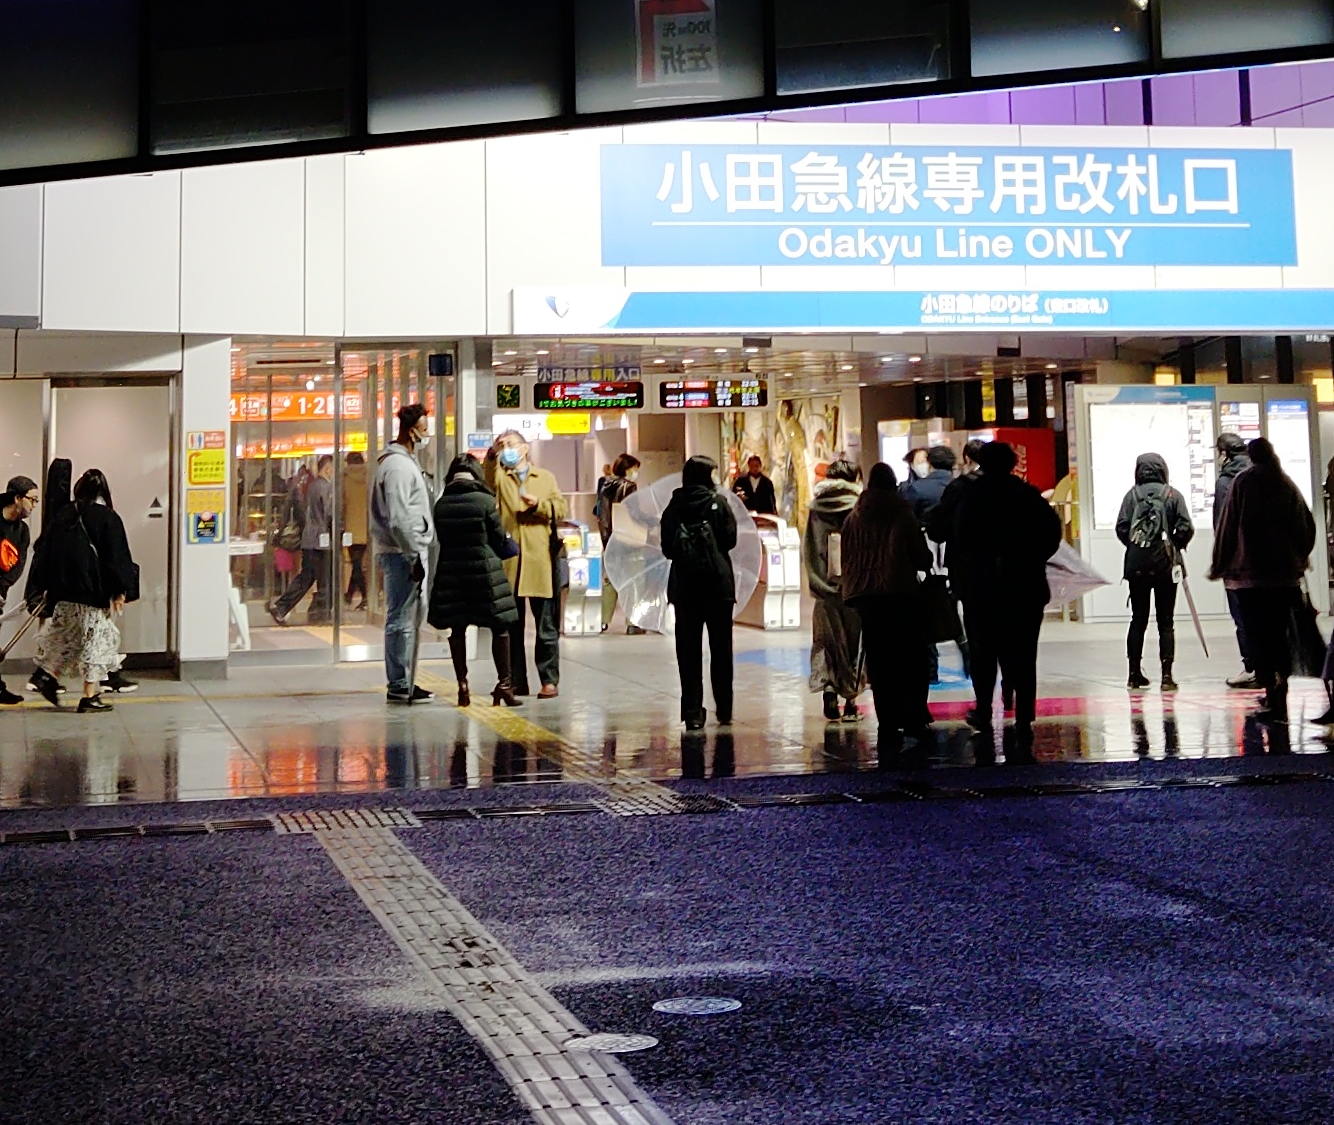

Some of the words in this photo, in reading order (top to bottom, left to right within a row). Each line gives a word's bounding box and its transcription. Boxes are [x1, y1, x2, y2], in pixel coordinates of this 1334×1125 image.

[655, 150, 1239, 216] 小田急線専用改札口
[778, 227, 922, 265] Odakyu
[936, 228, 1014, 259] Line
[1025, 228, 1132, 259] ONLY
